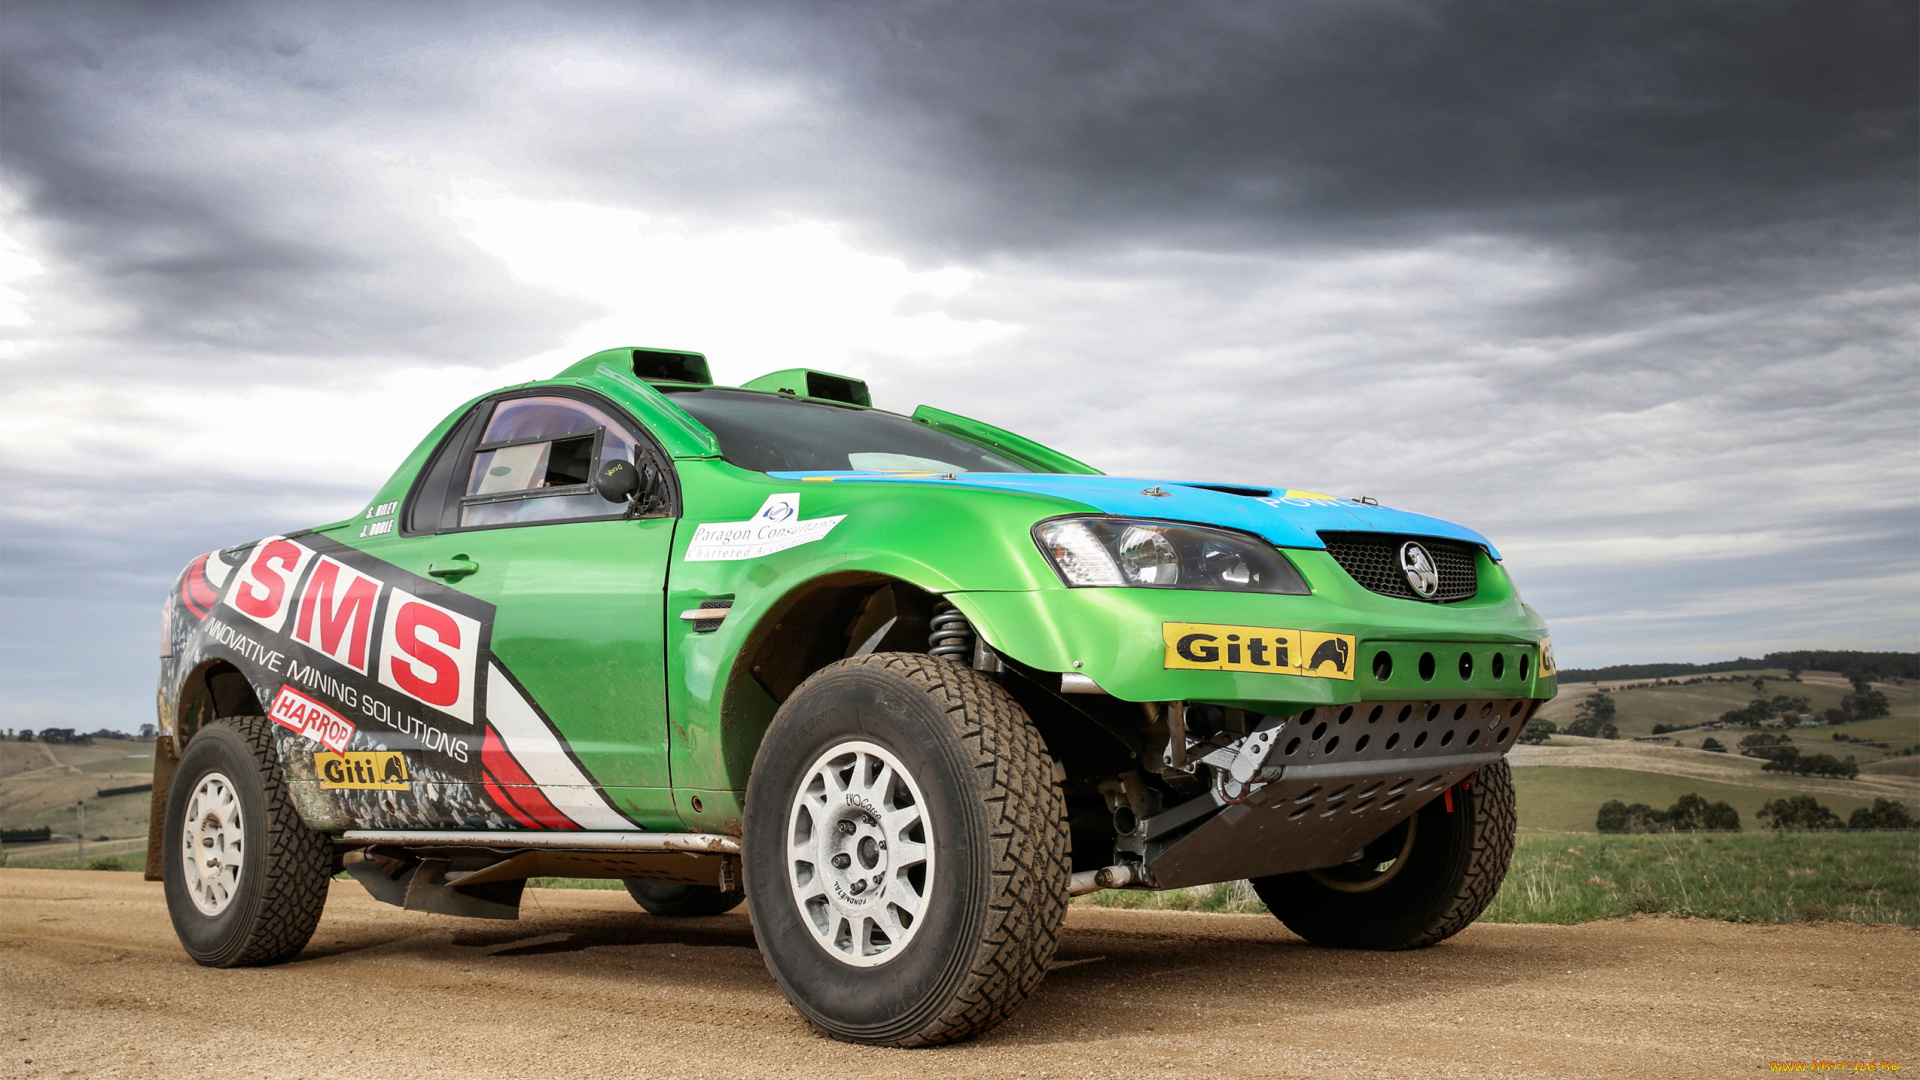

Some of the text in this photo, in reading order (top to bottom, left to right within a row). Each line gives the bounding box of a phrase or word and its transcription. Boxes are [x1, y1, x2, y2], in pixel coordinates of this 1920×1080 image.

[365, 500, 399, 519] S. RILEY
[360, 524, 367, 537] J.
[694, 519, 839, 545] Paragon Consultants
[688, 547, 751, 559] Chartered
[235, 539, 462, 707] SMS
[1176, 633, 1289, 667] Giti
[203, 616, 469, 763] INNOVATIVE MINING SOLUTIONS
[276, 695, 349, 745] HARROP
[323, 759, 375, 784] Giti
